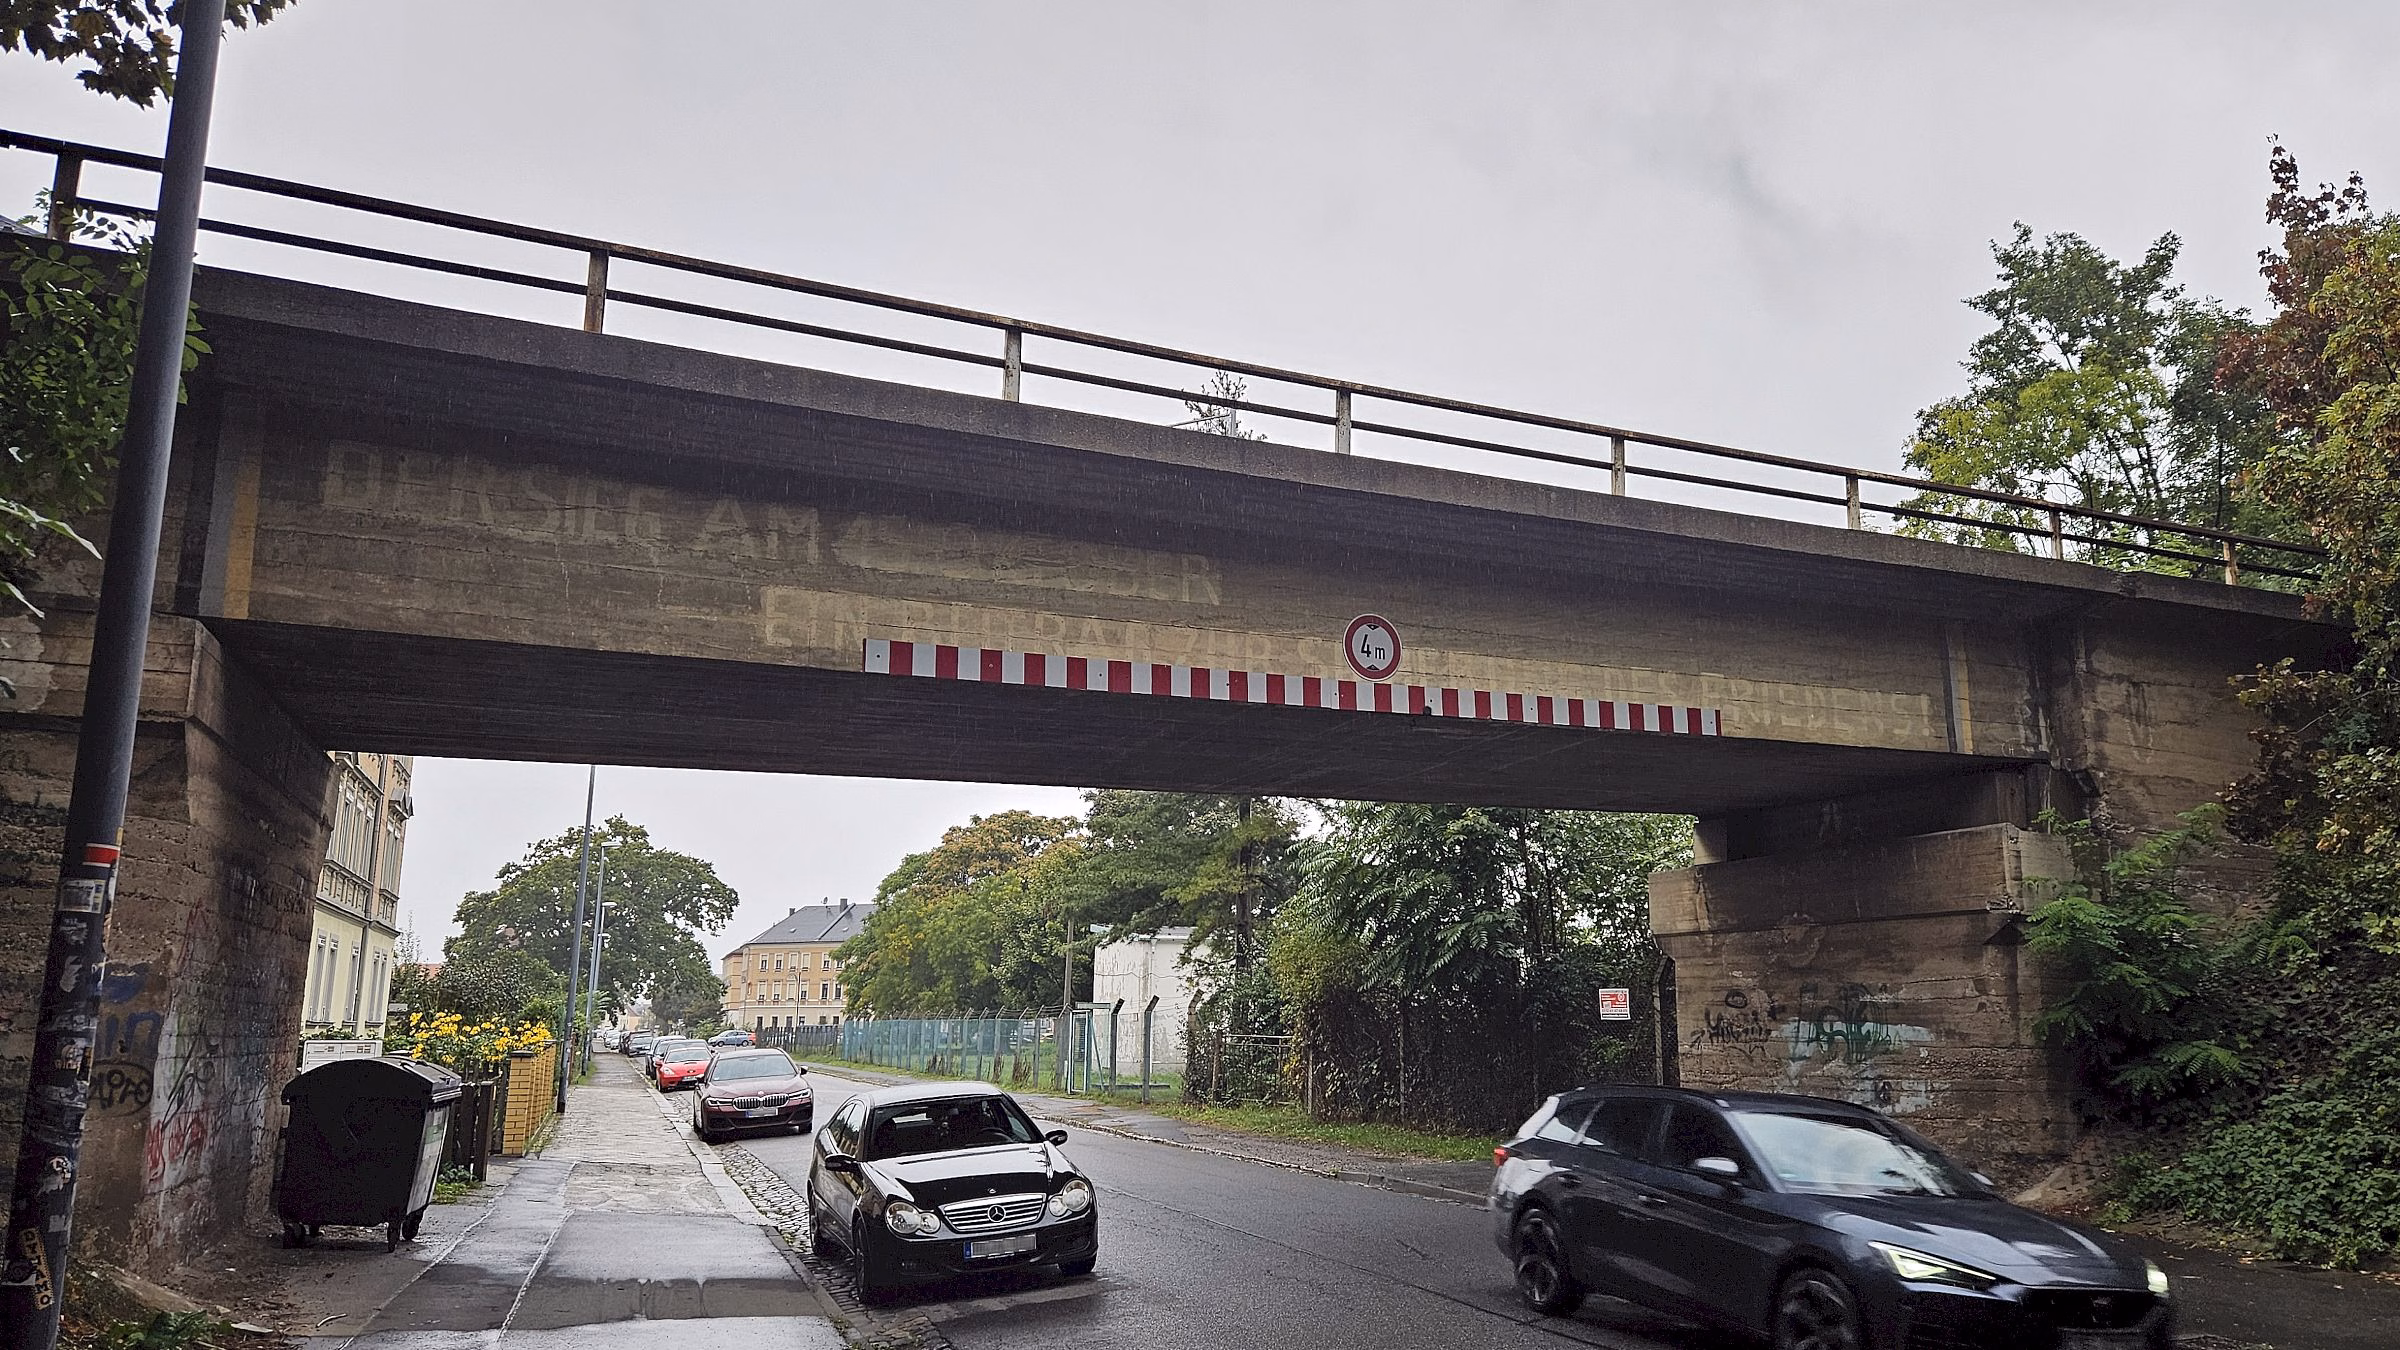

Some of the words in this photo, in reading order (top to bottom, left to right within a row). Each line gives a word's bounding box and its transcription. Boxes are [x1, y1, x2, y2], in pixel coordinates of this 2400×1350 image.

[696, 493, 823, 566] AM
[1361, 634, 1371, 657] 4
[1375, 647, 1385, 660] m
